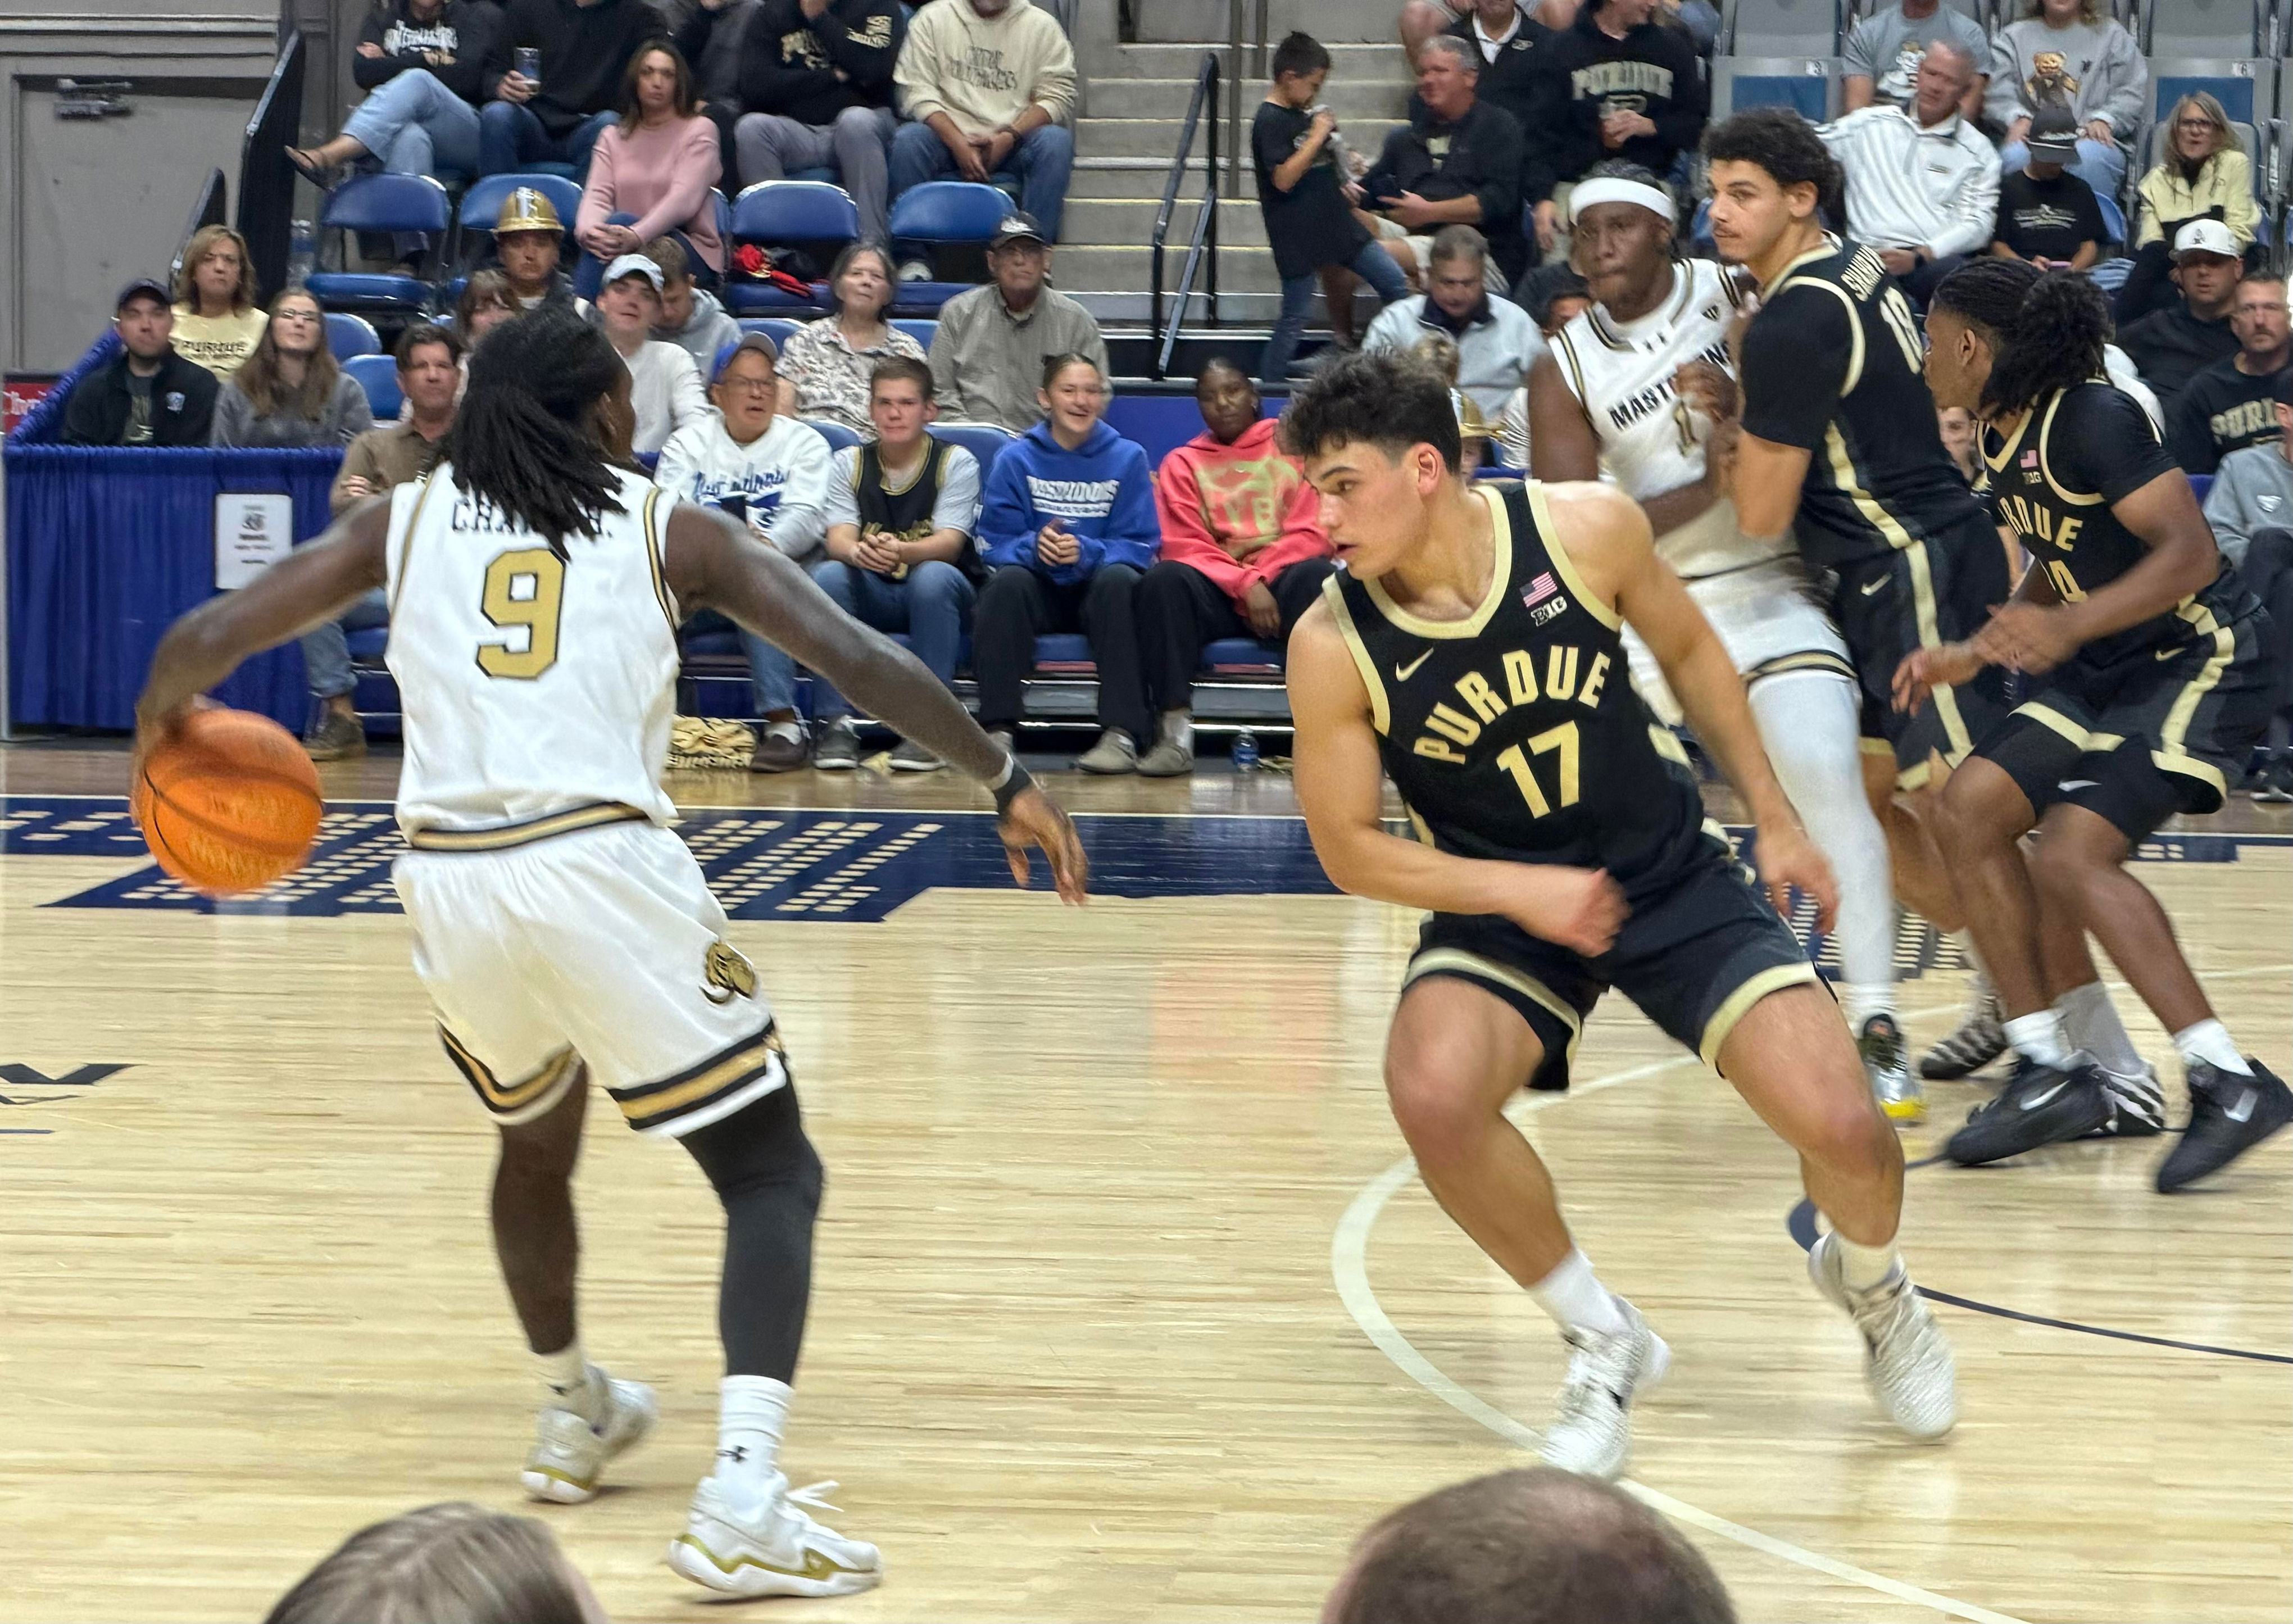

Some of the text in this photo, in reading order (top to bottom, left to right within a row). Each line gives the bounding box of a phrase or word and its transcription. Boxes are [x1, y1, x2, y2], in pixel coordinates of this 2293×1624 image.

[1998, 495, 2083, 552] RDUE
[476, 548, 566, 681] 9
[1413, 645, 1611, 765] PURDUE
[1496, 720, 1579, 819] 17
